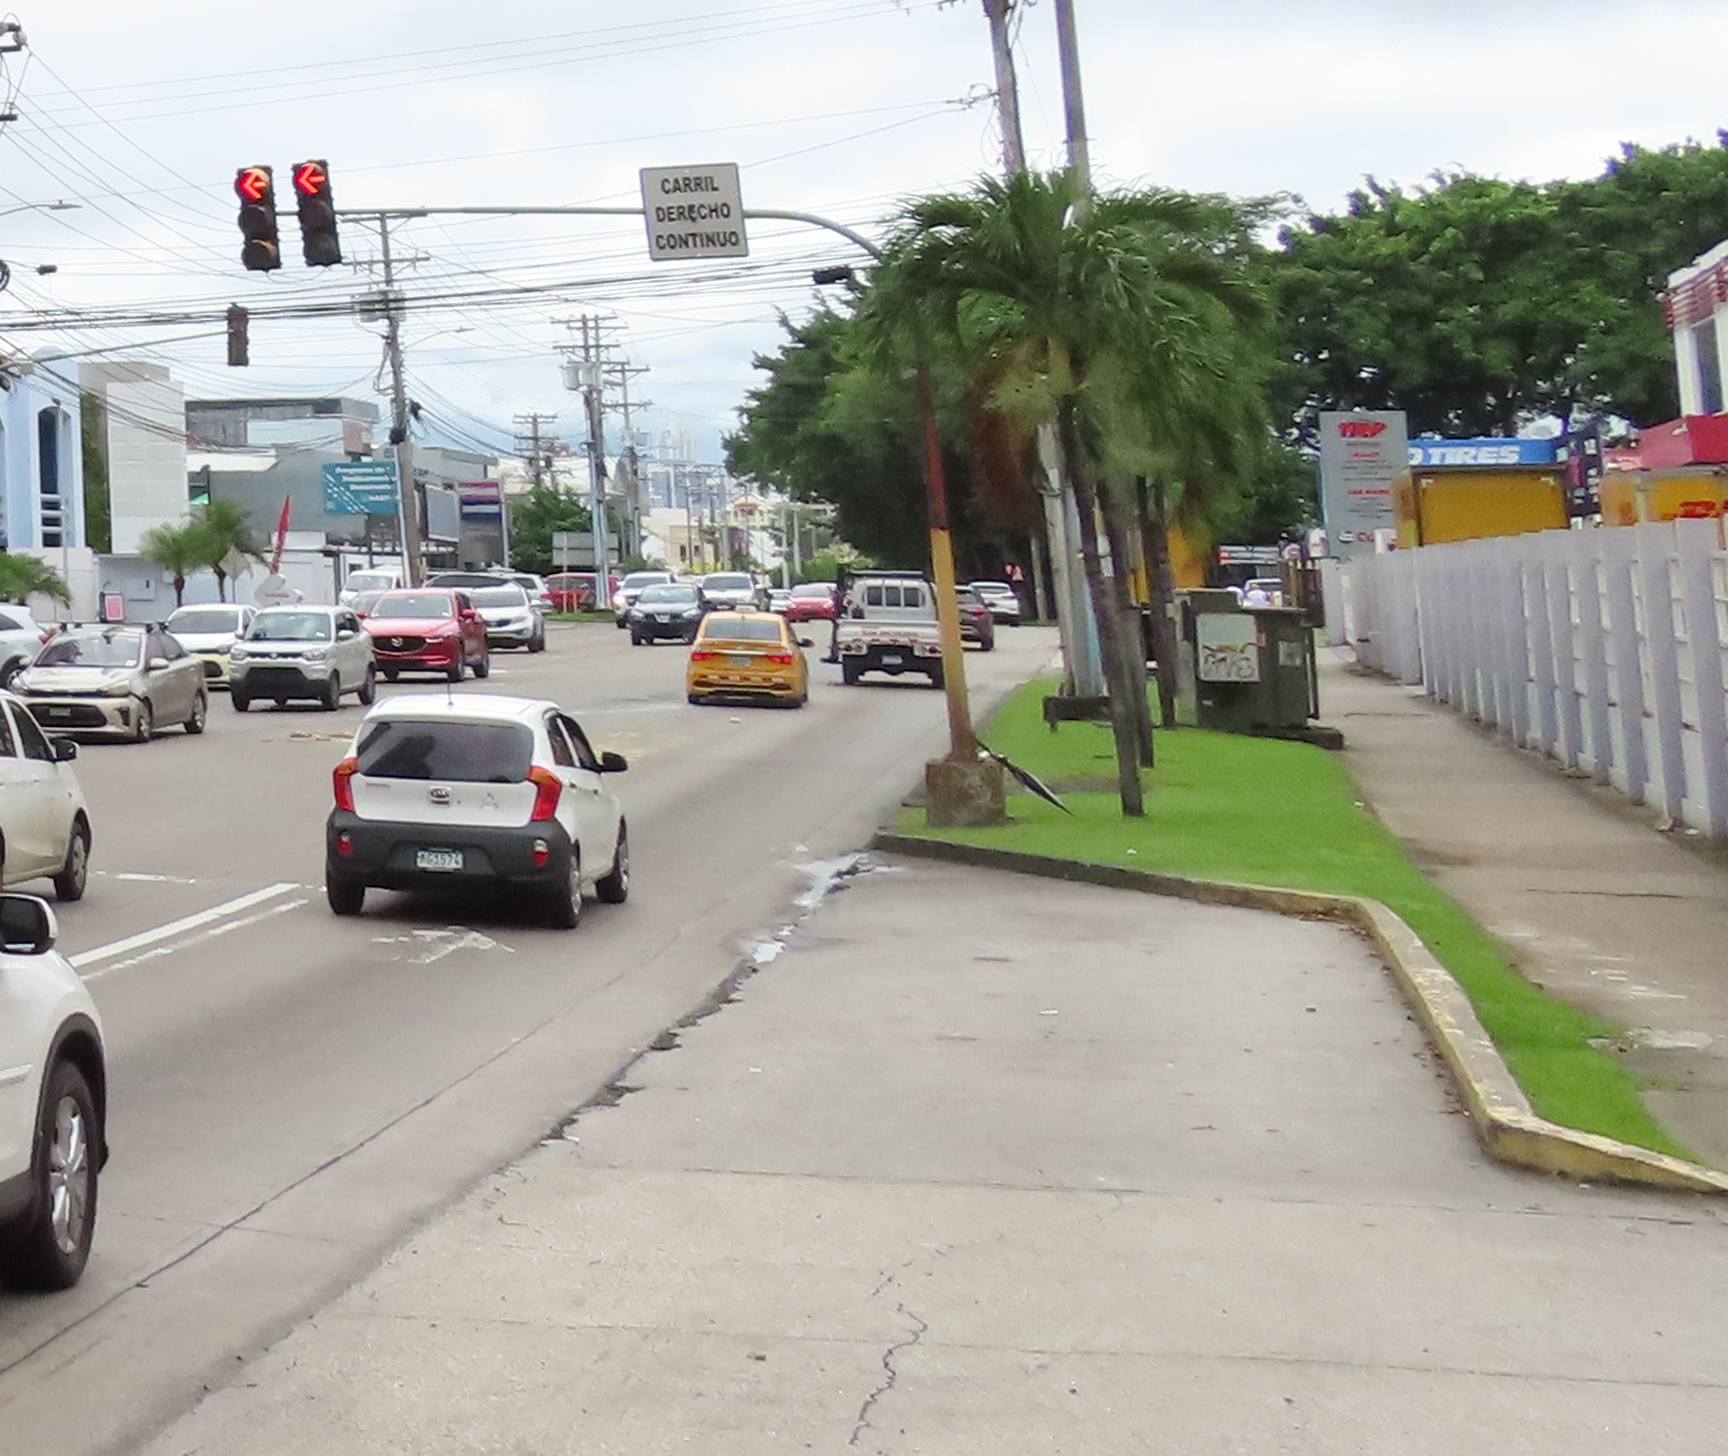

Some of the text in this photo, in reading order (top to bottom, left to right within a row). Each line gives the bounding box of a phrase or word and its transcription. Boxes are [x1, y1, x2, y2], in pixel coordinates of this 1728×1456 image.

[661, 176, 719, 194] CARRIL
[655, 202, 731, 223] DERECHO
[656, 231, 739, 250] CONTINUO
[1428, 446, 1520, 464] TIRES
